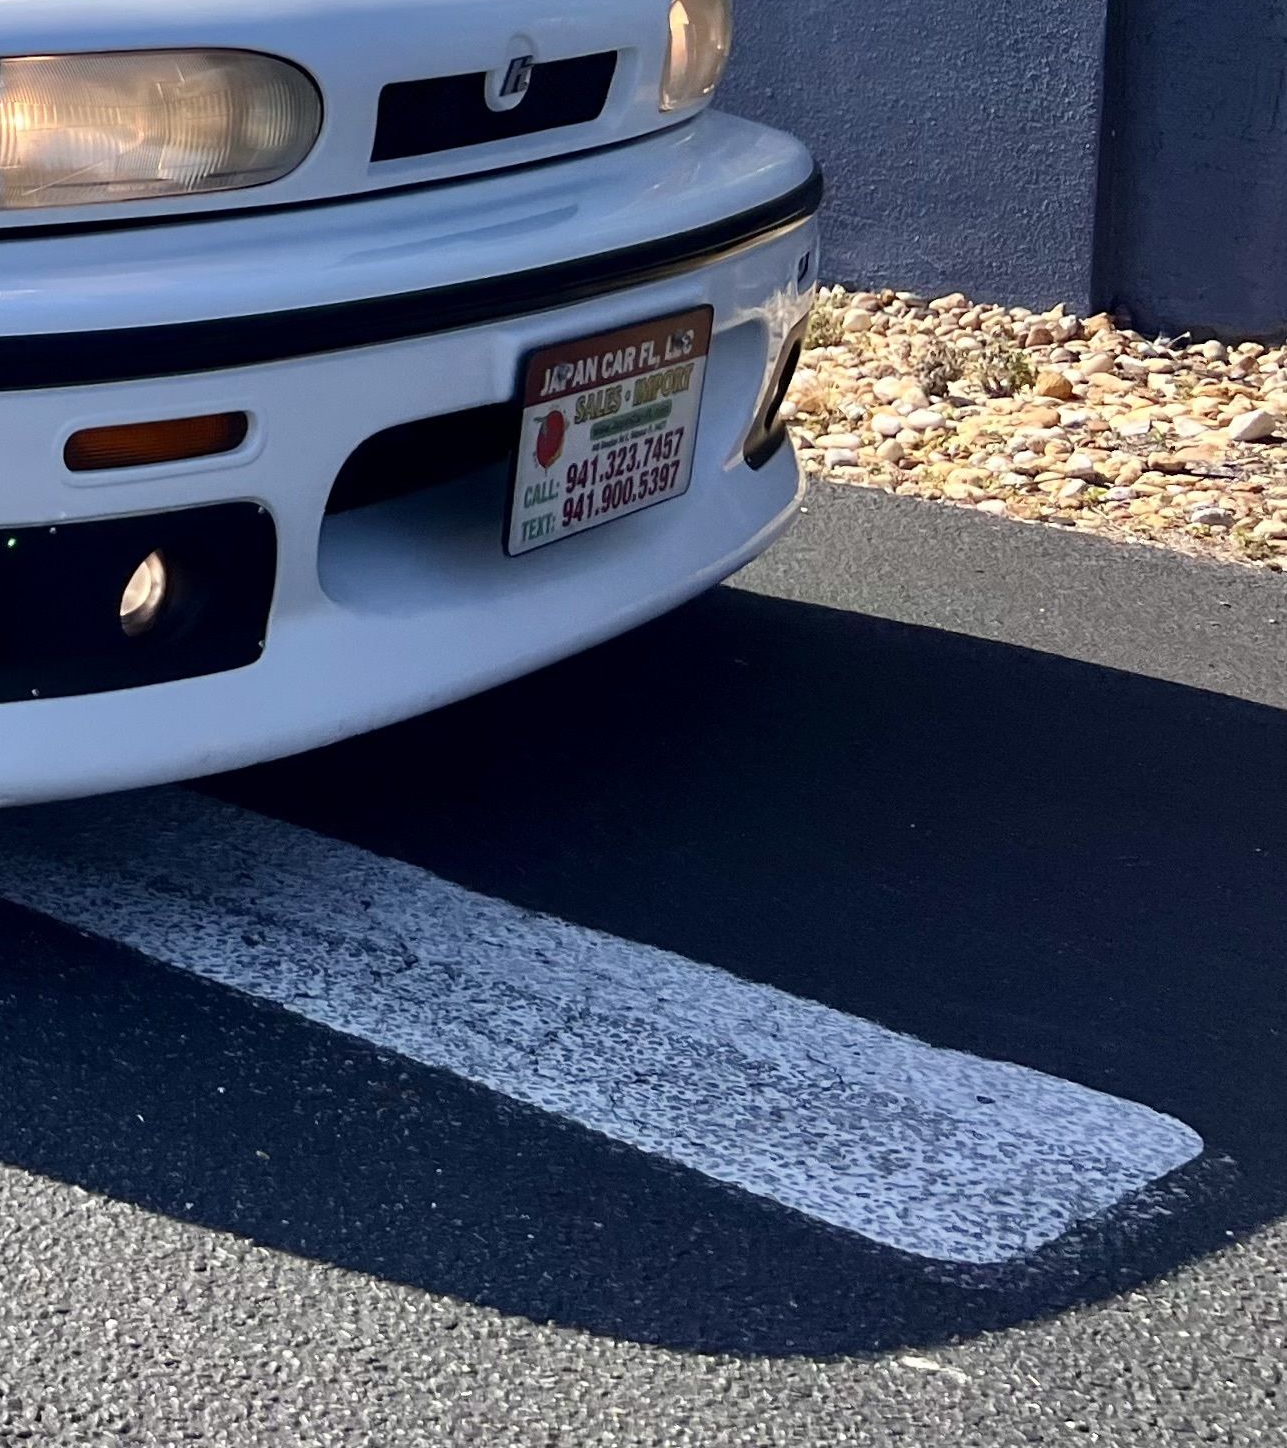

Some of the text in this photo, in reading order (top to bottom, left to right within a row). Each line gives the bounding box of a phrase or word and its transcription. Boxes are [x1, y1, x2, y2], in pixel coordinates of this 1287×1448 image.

[540, 355, 600, 397] JAPAN
[601, 345, 637, 380] CAR
[574, 384, 623, 425] SALES
[632, 362, 695, 407] IMPORT
[522, 459, 681, 541] TEXT: 941.900.5397
[524, 480, 560, 509] CALL:
[565, 426, 685, 494] 941.323.7457
